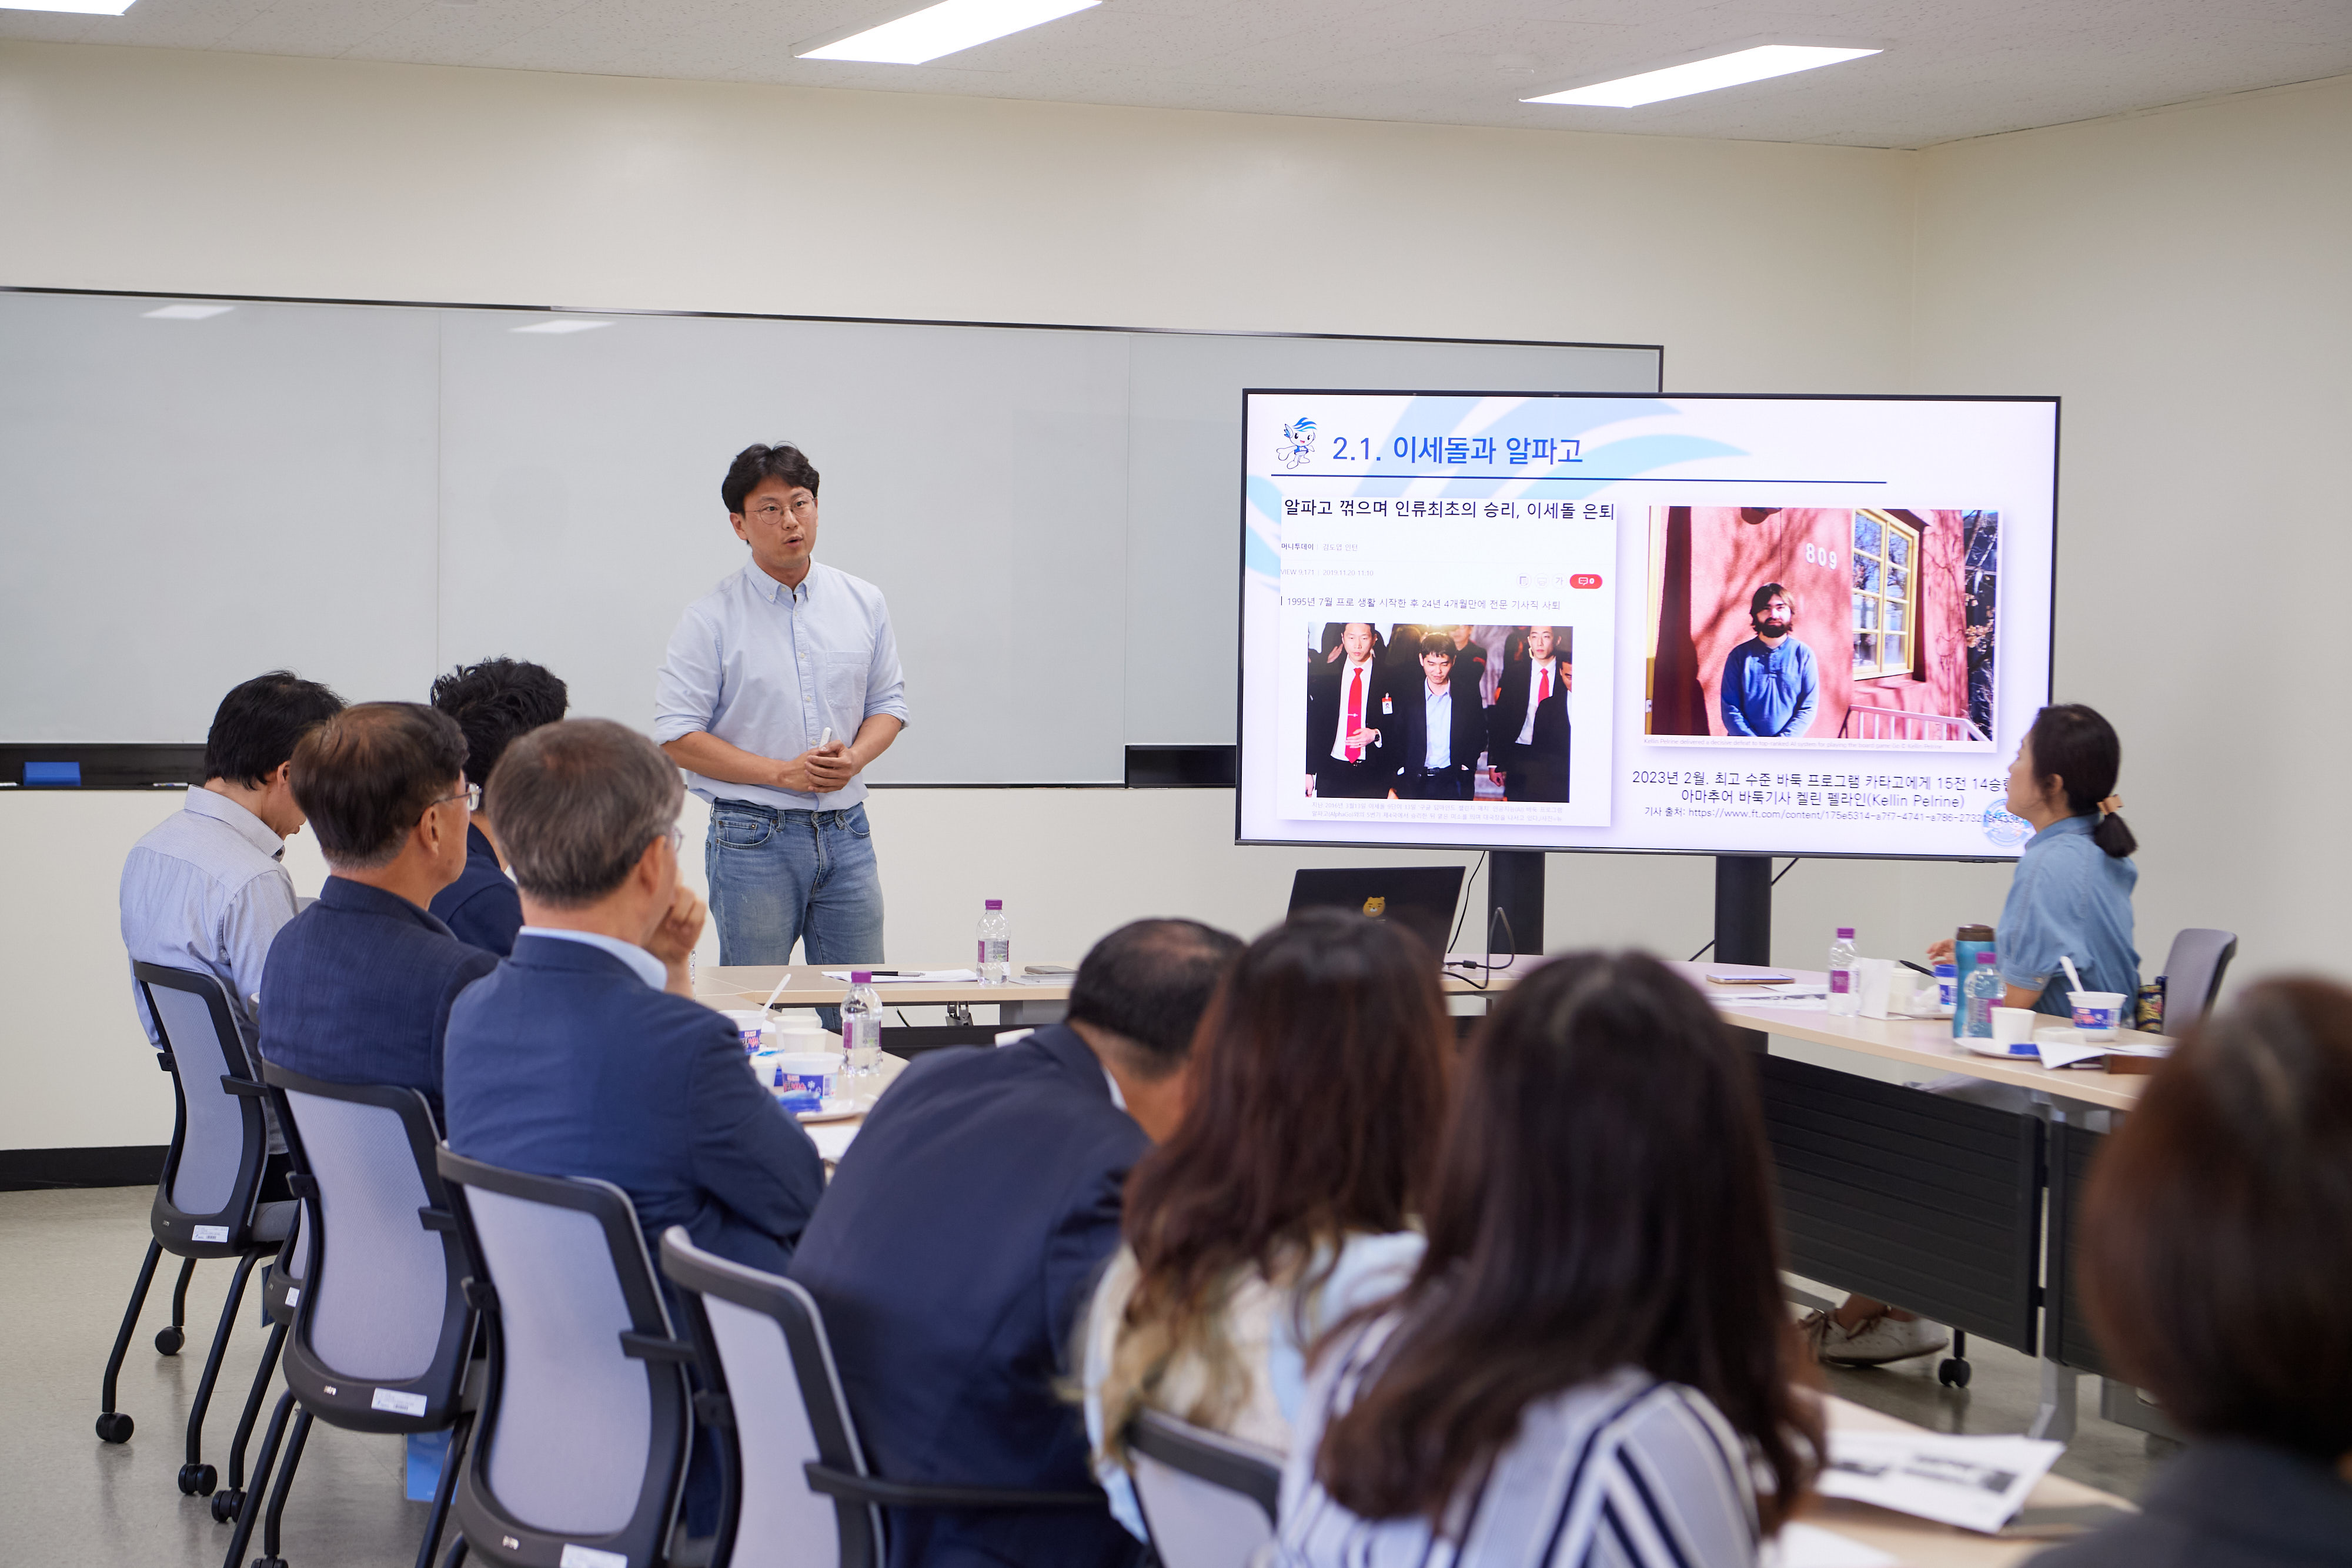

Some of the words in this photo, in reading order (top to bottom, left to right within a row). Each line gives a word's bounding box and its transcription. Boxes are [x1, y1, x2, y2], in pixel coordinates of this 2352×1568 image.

[1333, 437, 1381, 461] 2.1.
[1394, 436, 1496, 464] 이세돌과
[1506, 437, 1583, 465] 알파고
[1285, 499, 1333, 516] 알파고
[1339, 499, 1387, 517] 꺾으며
[1395, 500, 1476, 518] 인류최초의
[1484, 502, 1519, 519] 승리,
[1527, 502, 1576, 519] 이세돌
[1583, 503, 1614, 520] 은퇴
[1323, 543, 1342, 551] 김도엽
[1806, 543, 1838, 570] 809
[1555, 577, 1564, 585] 가
[1287, 597, 1315, 607] 1995년
[1318, 597, 1333, 607] 7월
[1336, 598, 1355, 607] 프로
[1358, 597, 1375, 607] 생활
[1379, 598, 1406, 608] 시작한
[1410, 599, 1419, 609] 후
[1422, 599, 1441, 609] 24년
[1444, 599, 1486, 610] 4개월만에
[1490, 600, 1508, 610] 전문
[1512, 600, 1538, 610] 기사직
[1542, 601, 1561, 610] 사퇴
[1632, 771, 1678, 785] 2023년
[1715, 772, 1740, 786] 최고
[1746, 773, 1772, 787] 수준
[1777, 774, 1803, 787] 바둑
[1807, 774, 1860, 789] 프로그램
[1866, 775, 1931, 790] 카타고에게
[1937, 777, 1967, 791] 15전
[1682, 790, 1733, 804] 아마추어
[1739, 791, 1792, 805] 바둑기사
[1797, 792, 1822, 806] 켈린
[1828, 793, 1908, 807] 펠라인(Kellin
[1913, 794, 1965, 809] Pelrine)
[1645, 807, 1662, 816] 기사
[1665, 807, 1686, 817] 출처:
